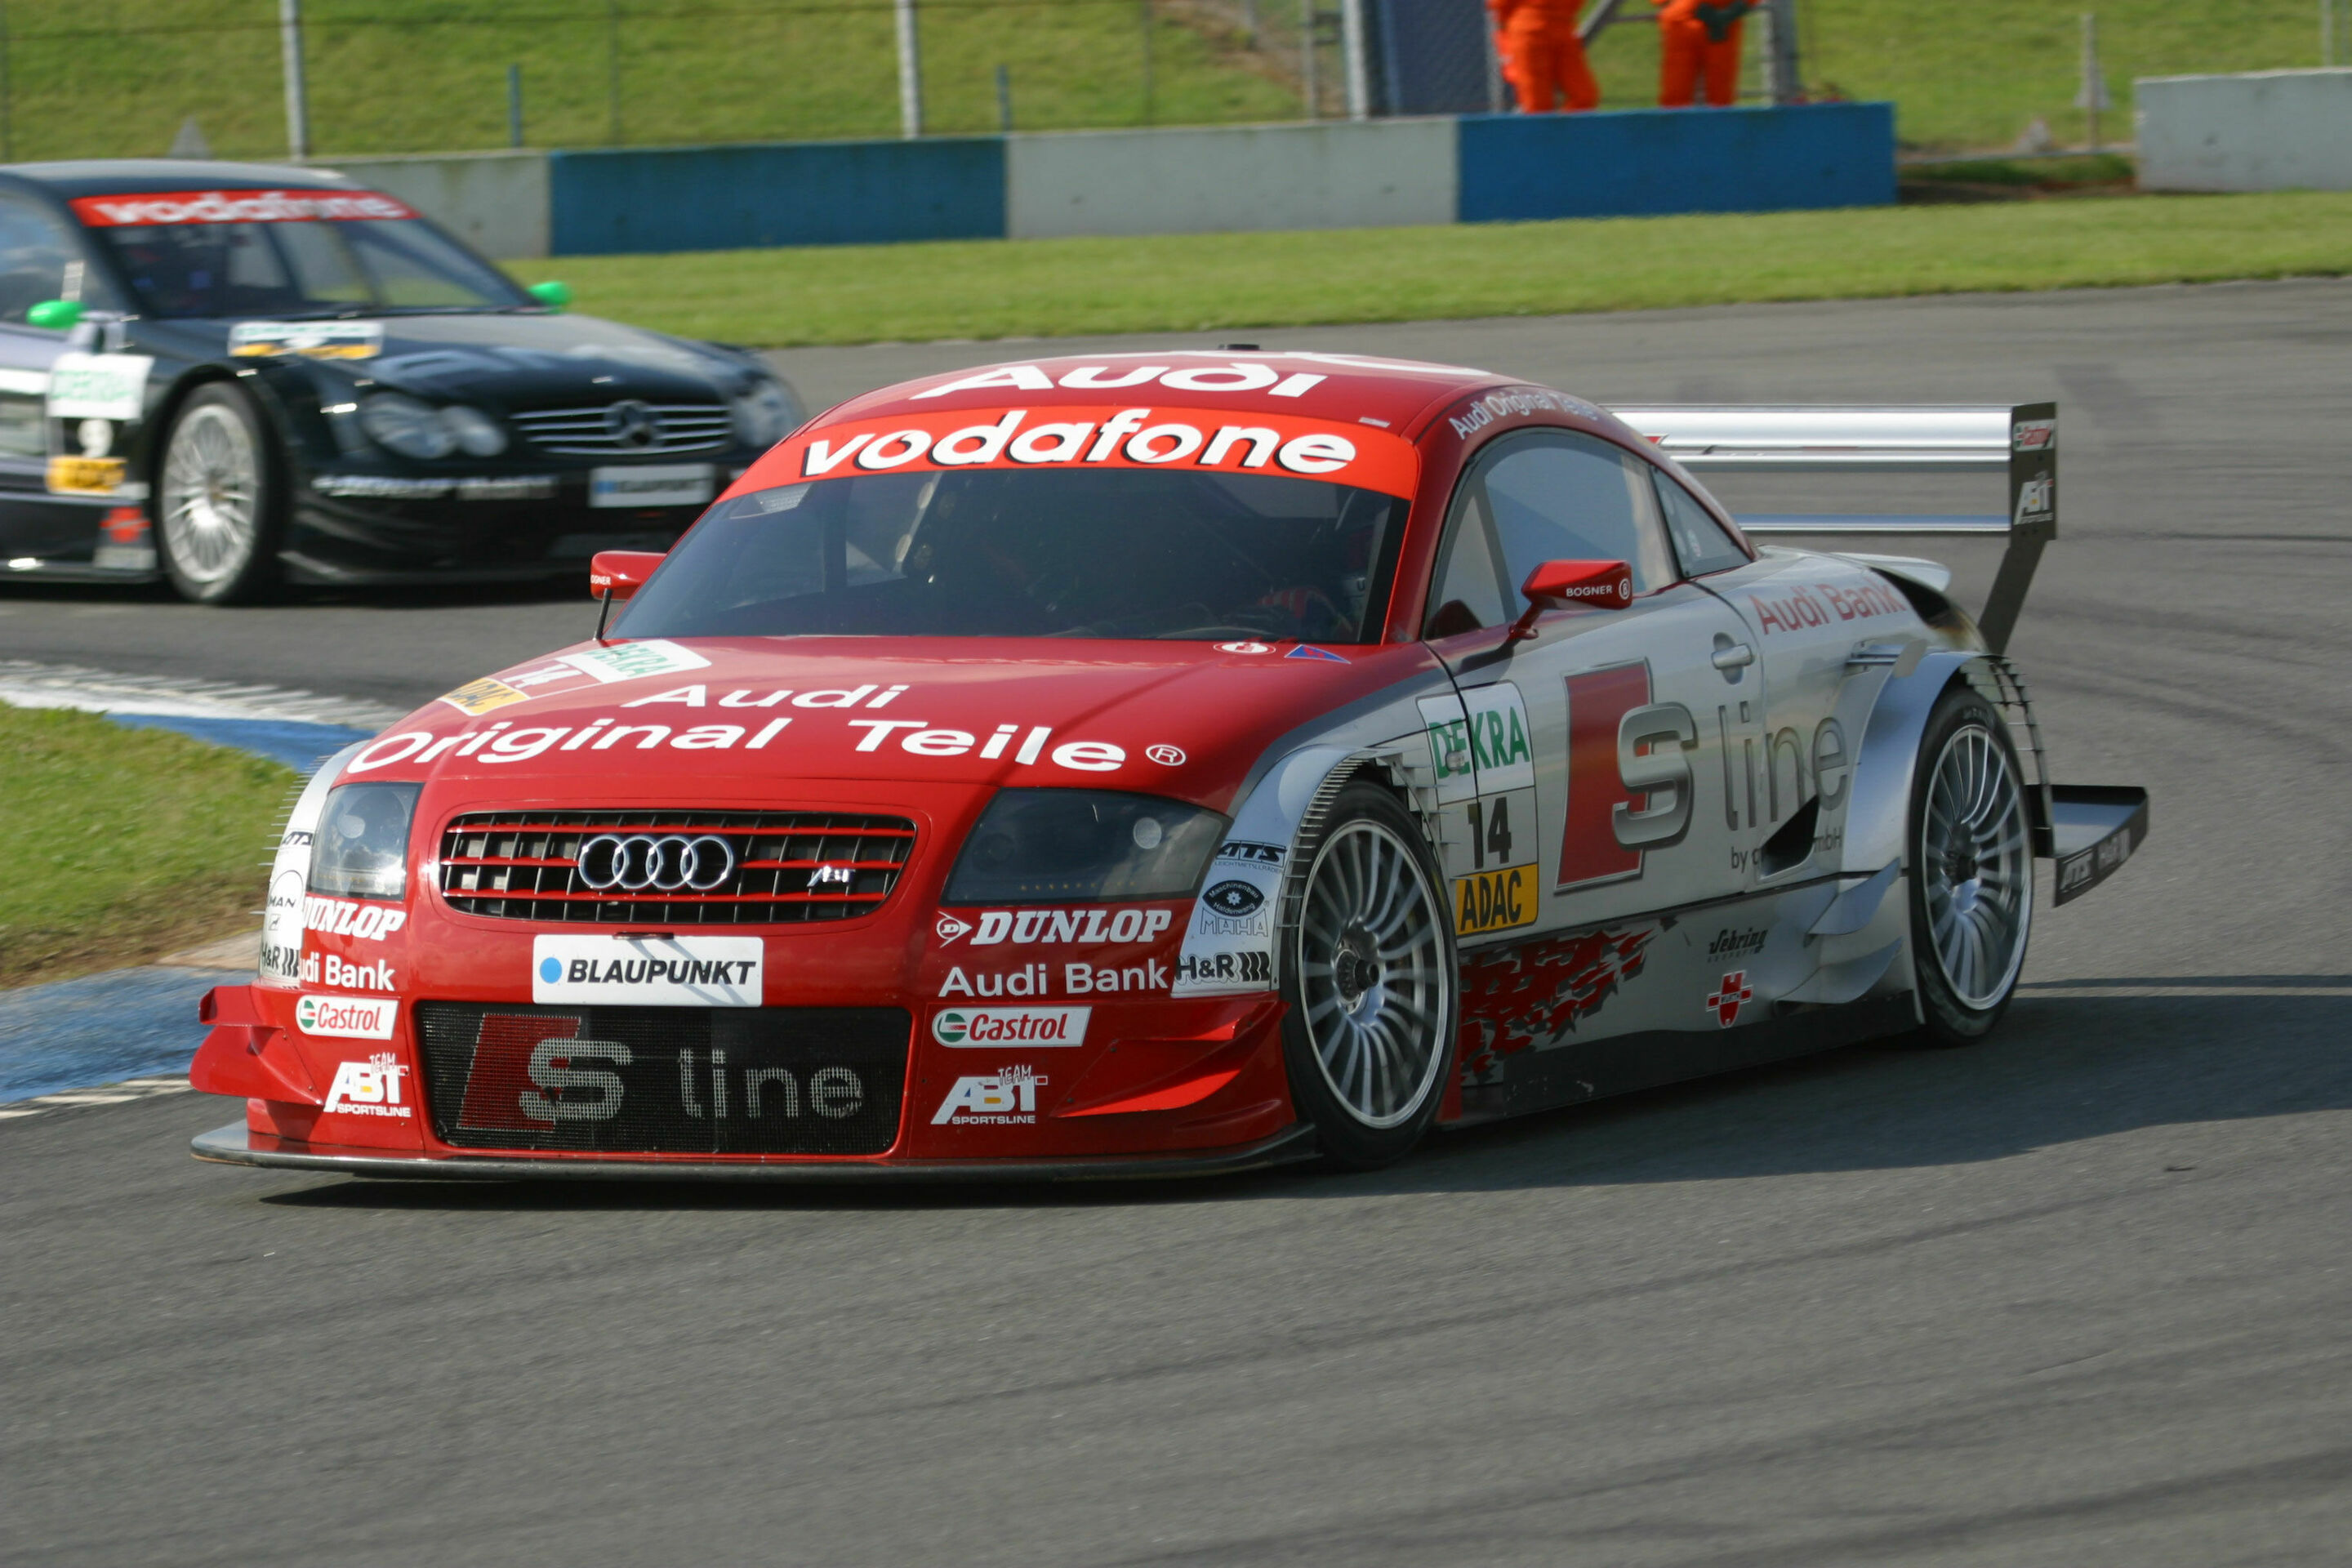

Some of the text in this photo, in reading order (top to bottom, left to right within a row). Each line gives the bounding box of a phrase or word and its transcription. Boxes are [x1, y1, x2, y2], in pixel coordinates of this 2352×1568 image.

[910, 363, 1329, 399] Audi
[1449, 401, 1493, 440] Audi
[803, 408, 1356, 477] vodafone
[1566, 585, 1613, 597] BOGNER
[1747, 576, 1908, 635] Audi Bank
[621, 684, 910, 709] Audi
[346, 718, 794, 773] Original
[848, 718, 1127, 773] Teile
[1428, 706, 1530, 779] DEKRA
[1611, 700, 1848, 851] S line
[1467, 796, 1512, 870] 14
[1812, 825, 1843, 854] mbH
[1216, 842, 1288, 864] ATS
[1731, 847, 1748, 873] by
[268, 897, 296, 908] MAN
[1460, 870, 1521, 932] ADAC
[969, 909, 1173, 946] DUNLOP
[1200, 906, 1269, 938] MAHA
[261, 942, 281, 969] H&R
[1176, 954, 1235, 981] H&R
[325, 954, 396, 992] Bank
[567, 959, 756, 986] BLAUPUNKT
[938, 958, 1169, 998] Audi Bank
[318, 1002, 381, 1031] Castrol
[969, 1013, 1068, 1041] Castrol
[369, 1052, 397, 1074] TEAM
[519, 1037, 863, 1121] S line
[998, 1065, 1032, 1086] TEAM
[323, 1062, 402, 1112] ABT
[930, 1076, 1036, 1125] ABT
[336, 1103, 412, 1118] SPORTSLINE
[951, 1115, 1036, 1125] SPORTSLINE
